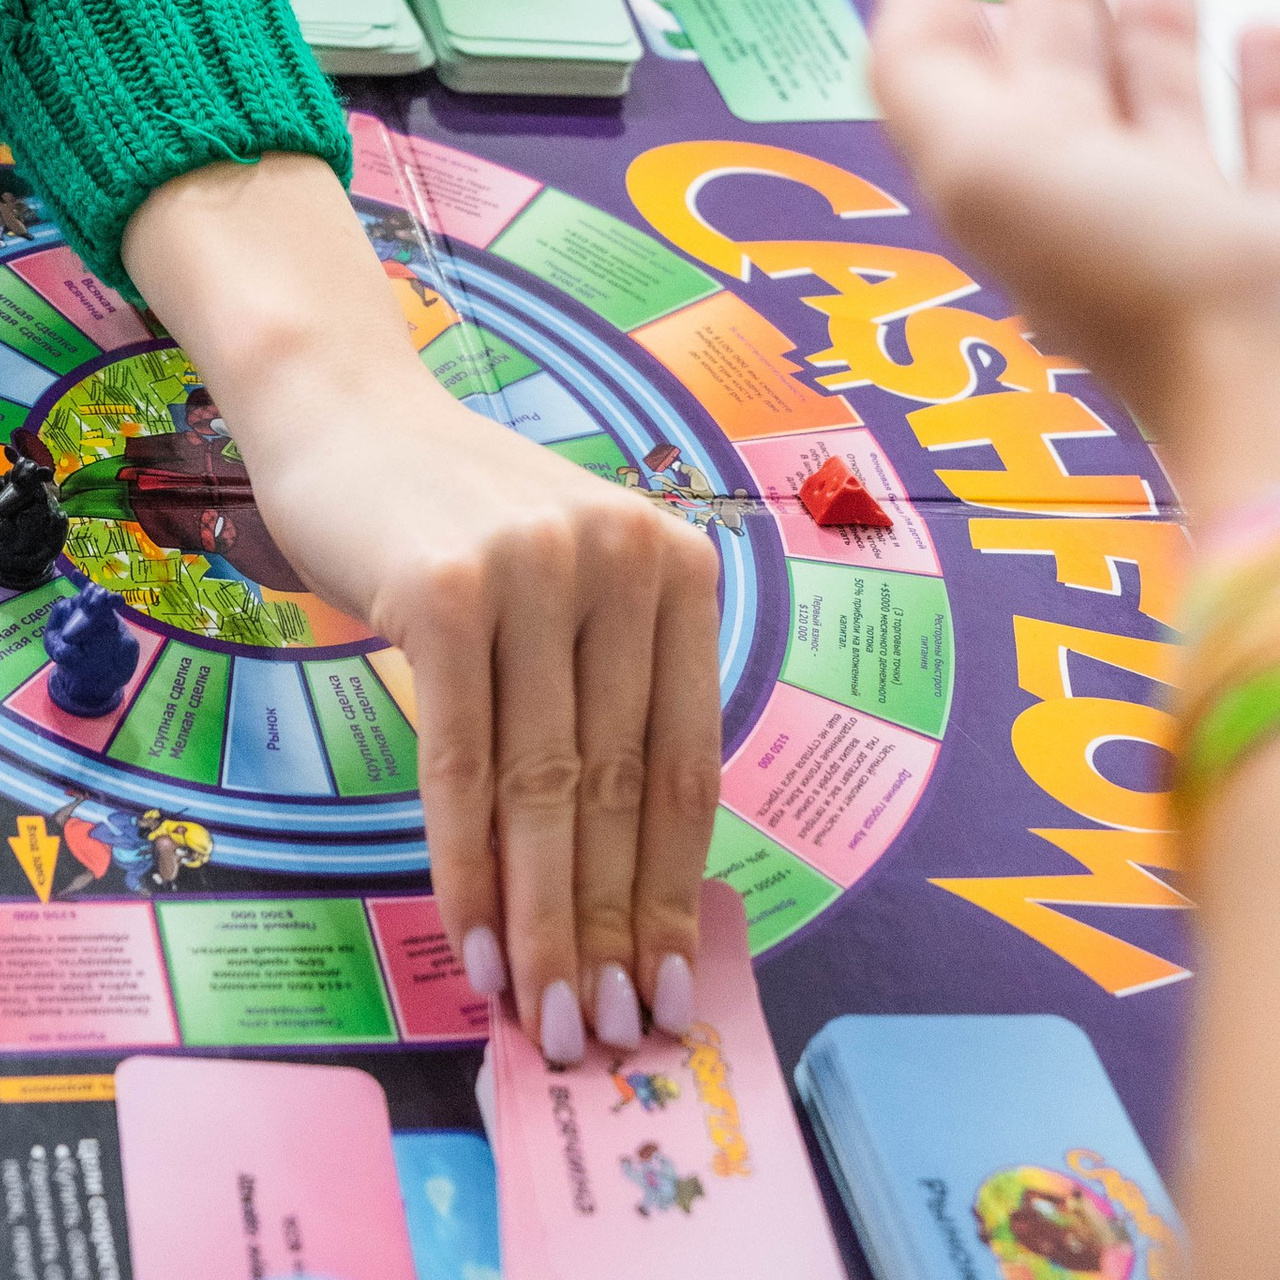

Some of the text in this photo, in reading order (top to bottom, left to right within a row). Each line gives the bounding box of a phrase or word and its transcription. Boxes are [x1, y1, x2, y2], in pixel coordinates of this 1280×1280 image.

[62, 277, 106, 322] всячина
[80, 274, 117, 315] Всякая
[15, 323, 63, 359] сделка
[32, 319, 78, 355] сделка
[502, 410, 540, 429] Рыно
[786, 475, 798, 490] для
[868, 451, 891, 491] Фондовая
[906, 526, 926, 550] детей
[864, 534, 883, 559] чтобы
[796, 603, 809, 641] $120 000
[810, 594, 822, 651] Первый взнос
[837, 614, 847, 650] капитал.
[849, 577, 863, 696] 50% прибыли на вложенный
[865, 624, 874, 653] потока
[876, 582, 890, 703] +$5000 месячного денежного
[890, 606, 904, 685] (3 торговые точки)
[919, 635, 928, 669] питания
[931, 613, 943, 697] Рестораны быстрого
[147, 655, 194, 759] Крупная сделка
[168, 663, 212, 760] Мелкая сделка
[348, 674, 400, 777] Мелкая сделка
[265, 706, 280, 750] Рынок
[327, 673, 384, 783] Крупная сделка
[818, 713, 858, 762] отдаленные
[863, 734, 880, 752] гид
[754, 711, 842, 820] еще не ступала нога туриста.
[757, 731, 790, 771] $150 000
[835, 735, 861, 764] ваших
[837, 749, 868, 786] доставят
[864, 740, 895, 777] Частный
[797, 757, 824, 788] уголки
[815, 759, 843, 791] друзей
[841, 772, 870, 807] самолет
[880, 767, 912, 804] Древние
[792, 793, 816, 821] самые
[826, 783, 843, 801] вас
[795, 803, 826, 840] пятерых
[811, 810, 841, 848] частный
[860, 799, 887, 830] города
